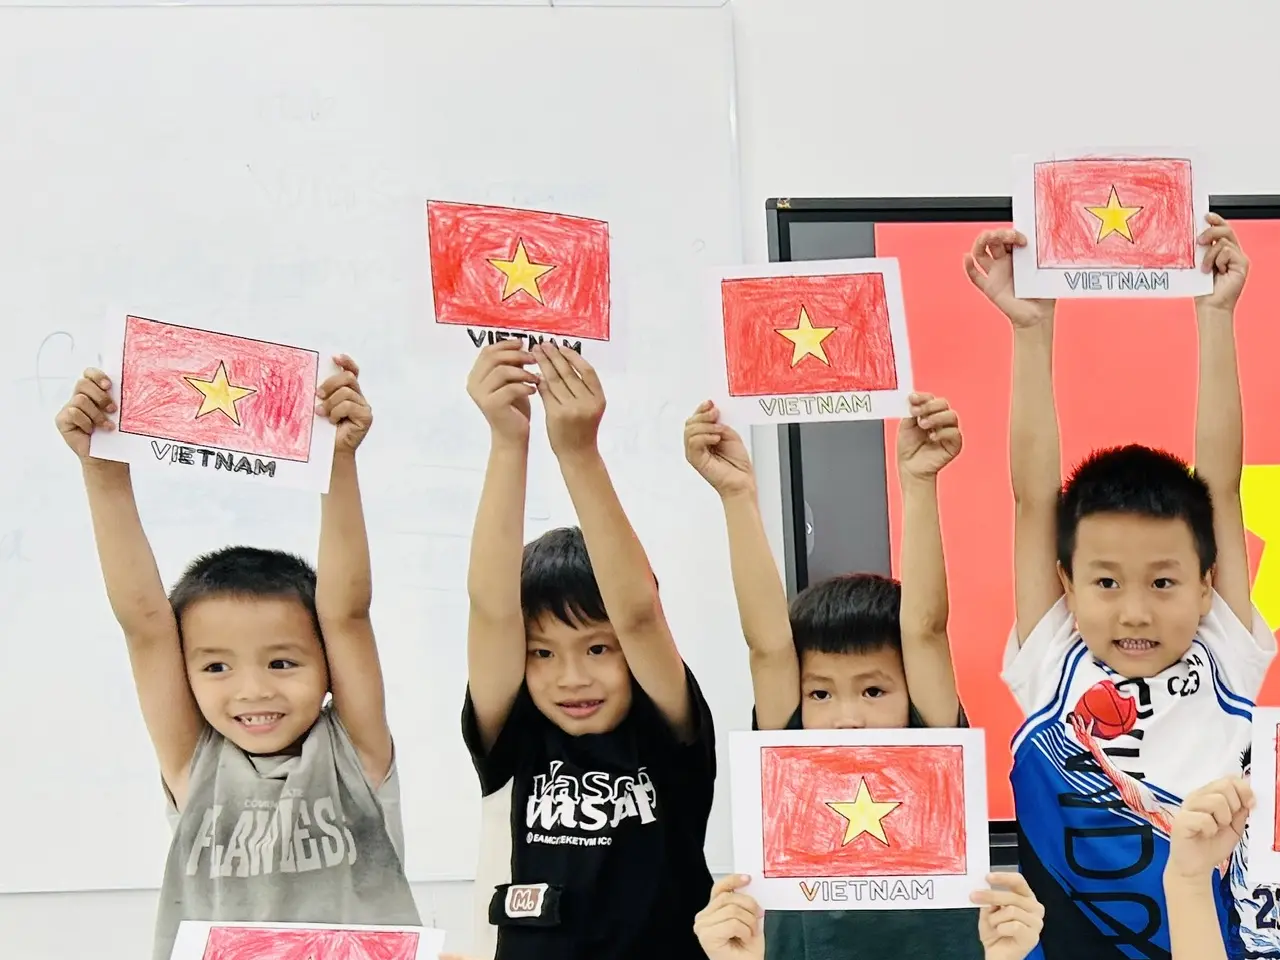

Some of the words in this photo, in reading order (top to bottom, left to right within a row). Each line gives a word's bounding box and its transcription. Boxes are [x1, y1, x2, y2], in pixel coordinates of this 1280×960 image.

[1063, 270, 1169, 291] VIETNAM
[759, 394, 872, 416] VIETNAM
[150, 440, 277, 478] VIETNAM
[799, 879, 934, 901] VIETNAM
